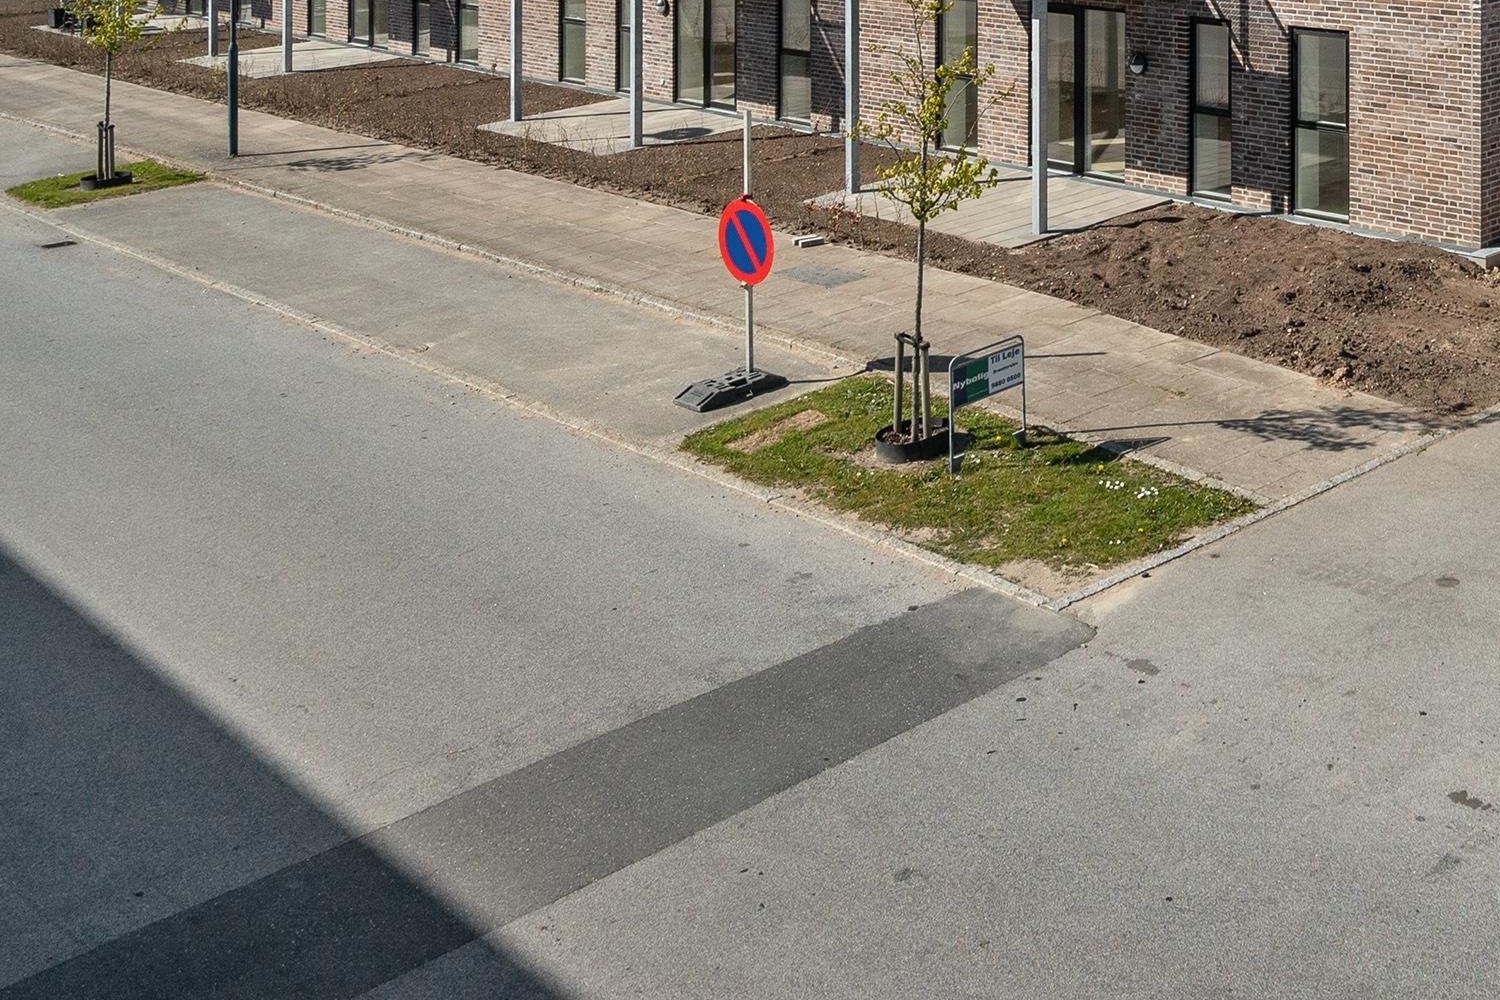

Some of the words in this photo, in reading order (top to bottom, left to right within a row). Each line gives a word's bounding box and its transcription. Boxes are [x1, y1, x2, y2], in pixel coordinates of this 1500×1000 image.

[991, 354, 1001, 365] Til
[1002, 348, 1020, 360] Leje
[953, 371, 989, 391] Nybolig
